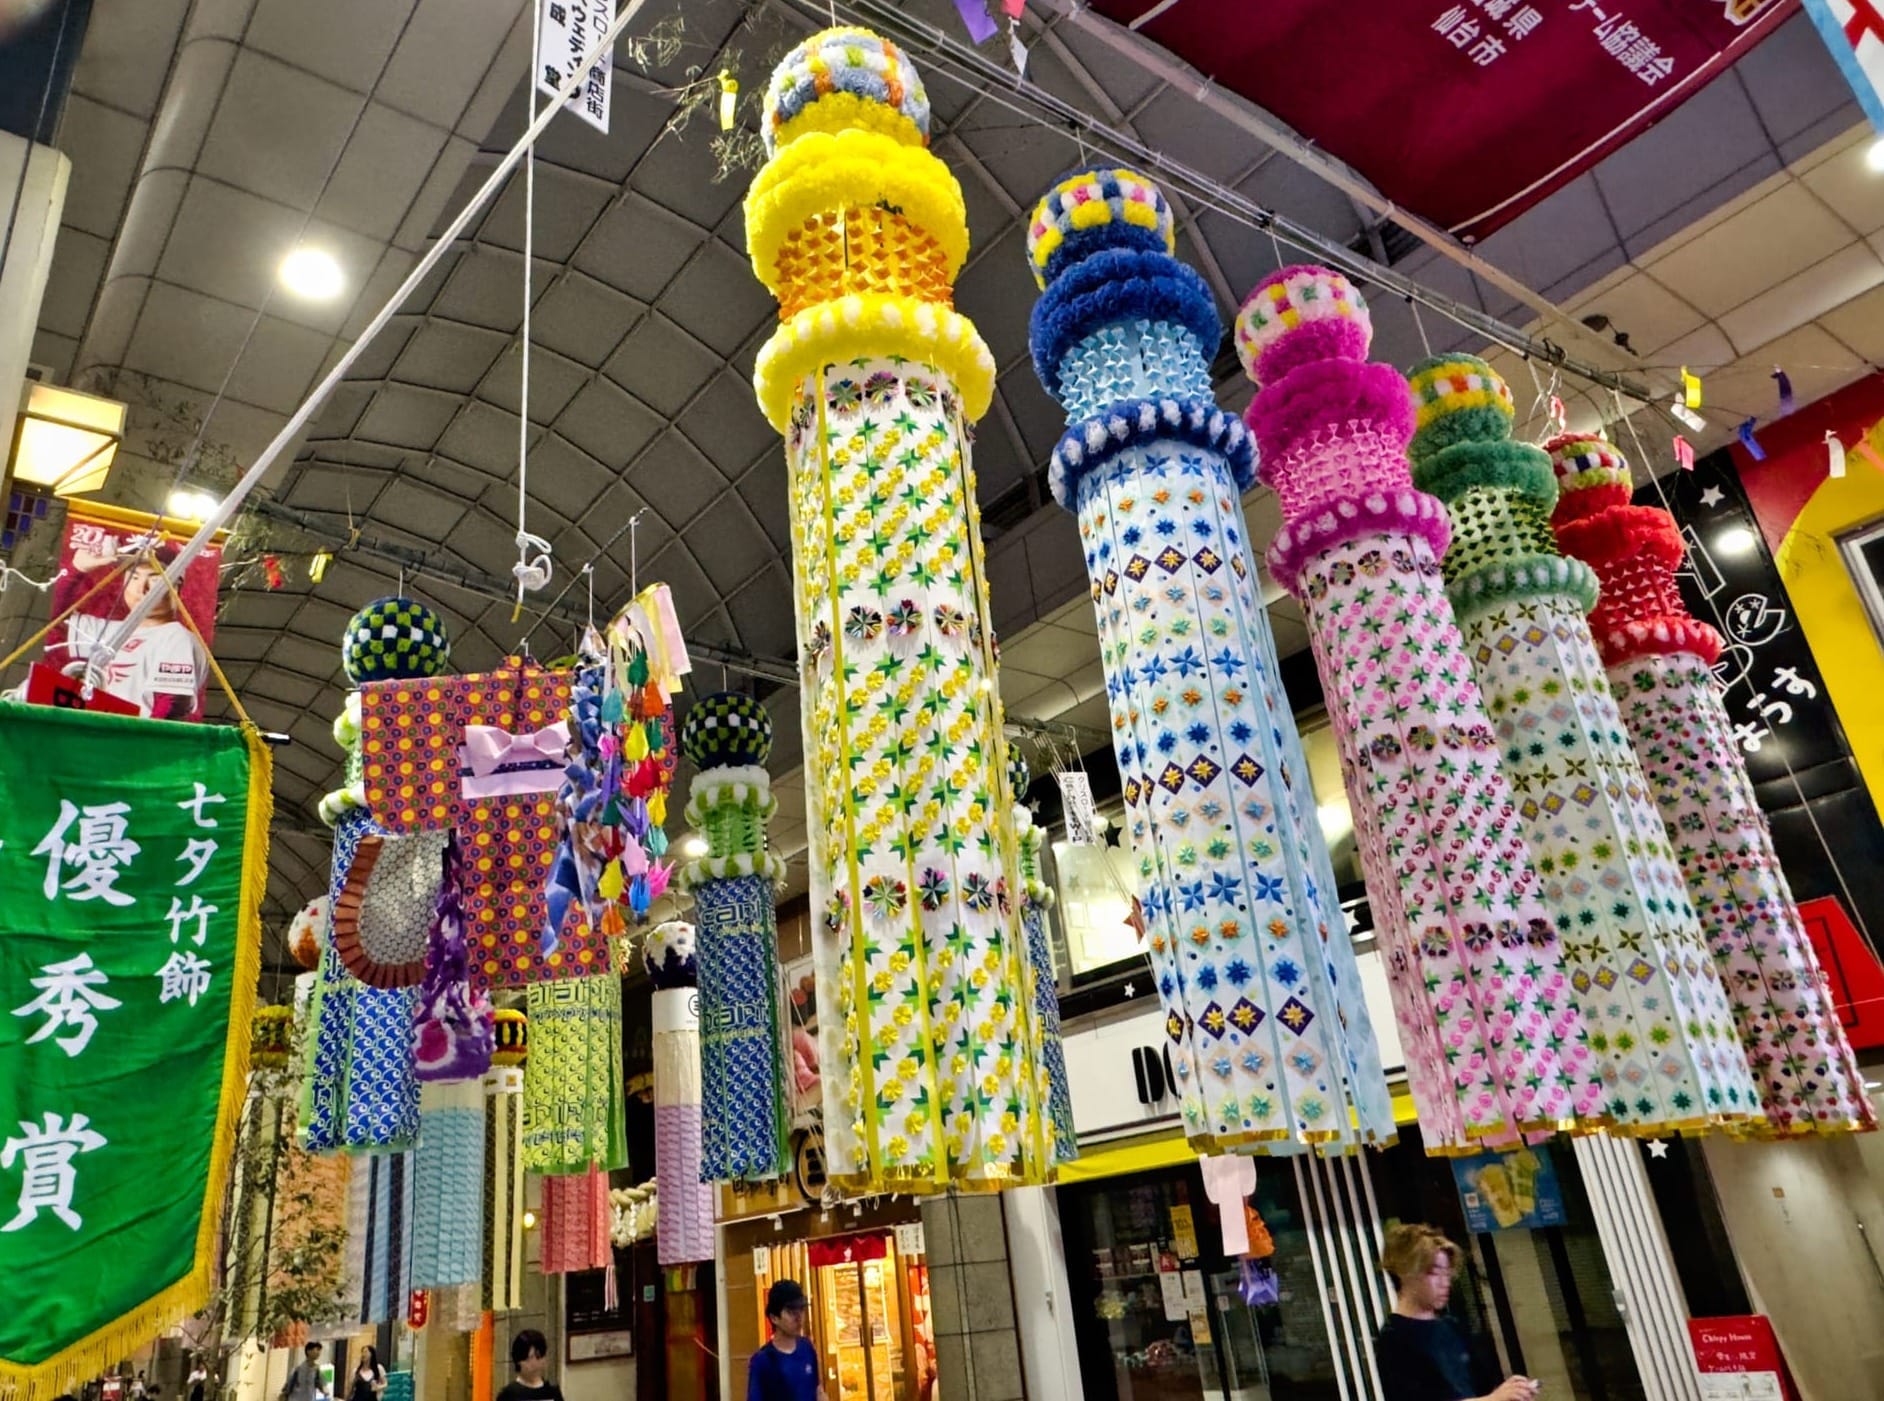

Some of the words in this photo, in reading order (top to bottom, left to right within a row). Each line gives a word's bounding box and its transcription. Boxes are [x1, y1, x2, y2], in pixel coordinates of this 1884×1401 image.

[586, 0, 610, 120] スロー商店街
[1430, 4, 1507, 67] 仙台市
[1469, 0, 1544, 41] 城県
[154, 782, 226, 1007] 七夕竹飾
[0, 799, 142, 1233] 優秀賞
